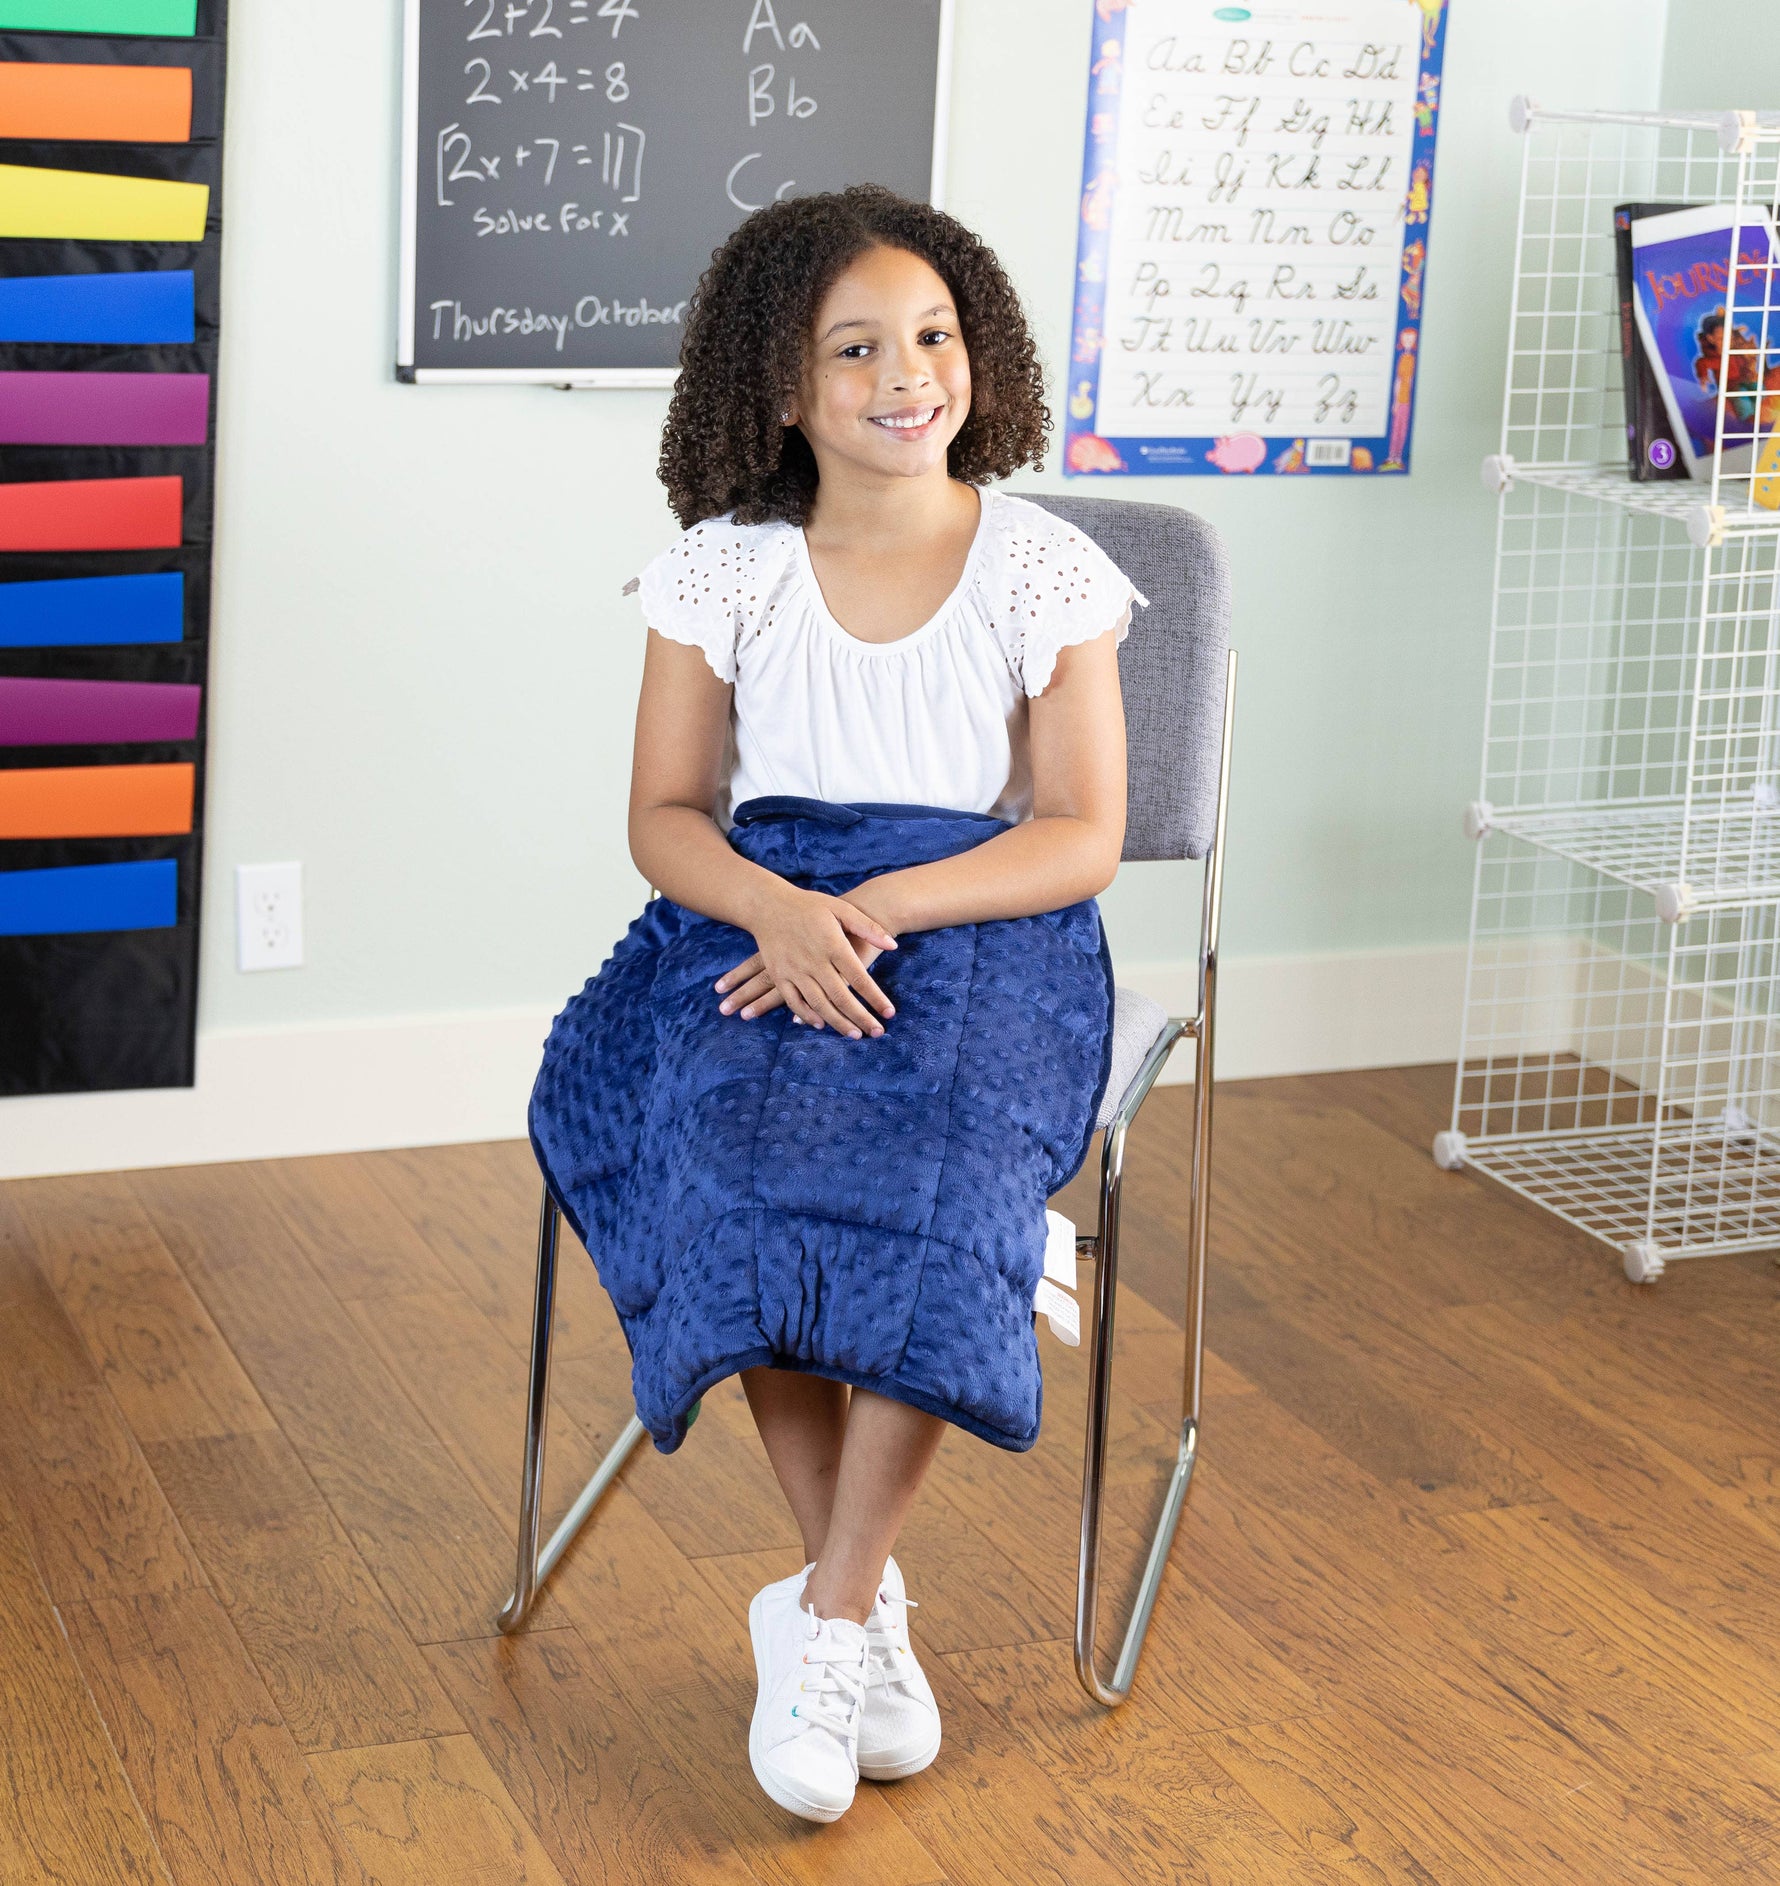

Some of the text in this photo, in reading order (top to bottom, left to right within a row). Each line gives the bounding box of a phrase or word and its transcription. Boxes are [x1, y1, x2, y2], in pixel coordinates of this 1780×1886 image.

[743, 0, 821, 54] Aa
[1146, 37, 1400, 80] Aa Bb Cc Dd
[749, 64, 818, 126] Bb
[1142, 94, 1396, 150] Ee Ff Gg Hh
[1138, 150, 1392, 203] Ii Jj Kk Ll
[473, 208, 551, 238] Solve
[1148, 206, 1376, 246] Mm Nn Oo
[575, 295, 688, 327] October
[1130, 261, 1379, 314] Pp Qq Rr Ss
[1120, 316, 1378, 355] Tt Uu Vv Ww
[1131, 372, 1358, 424] Xx Yy Zz
[1656, 443, 1668, 462] 3
